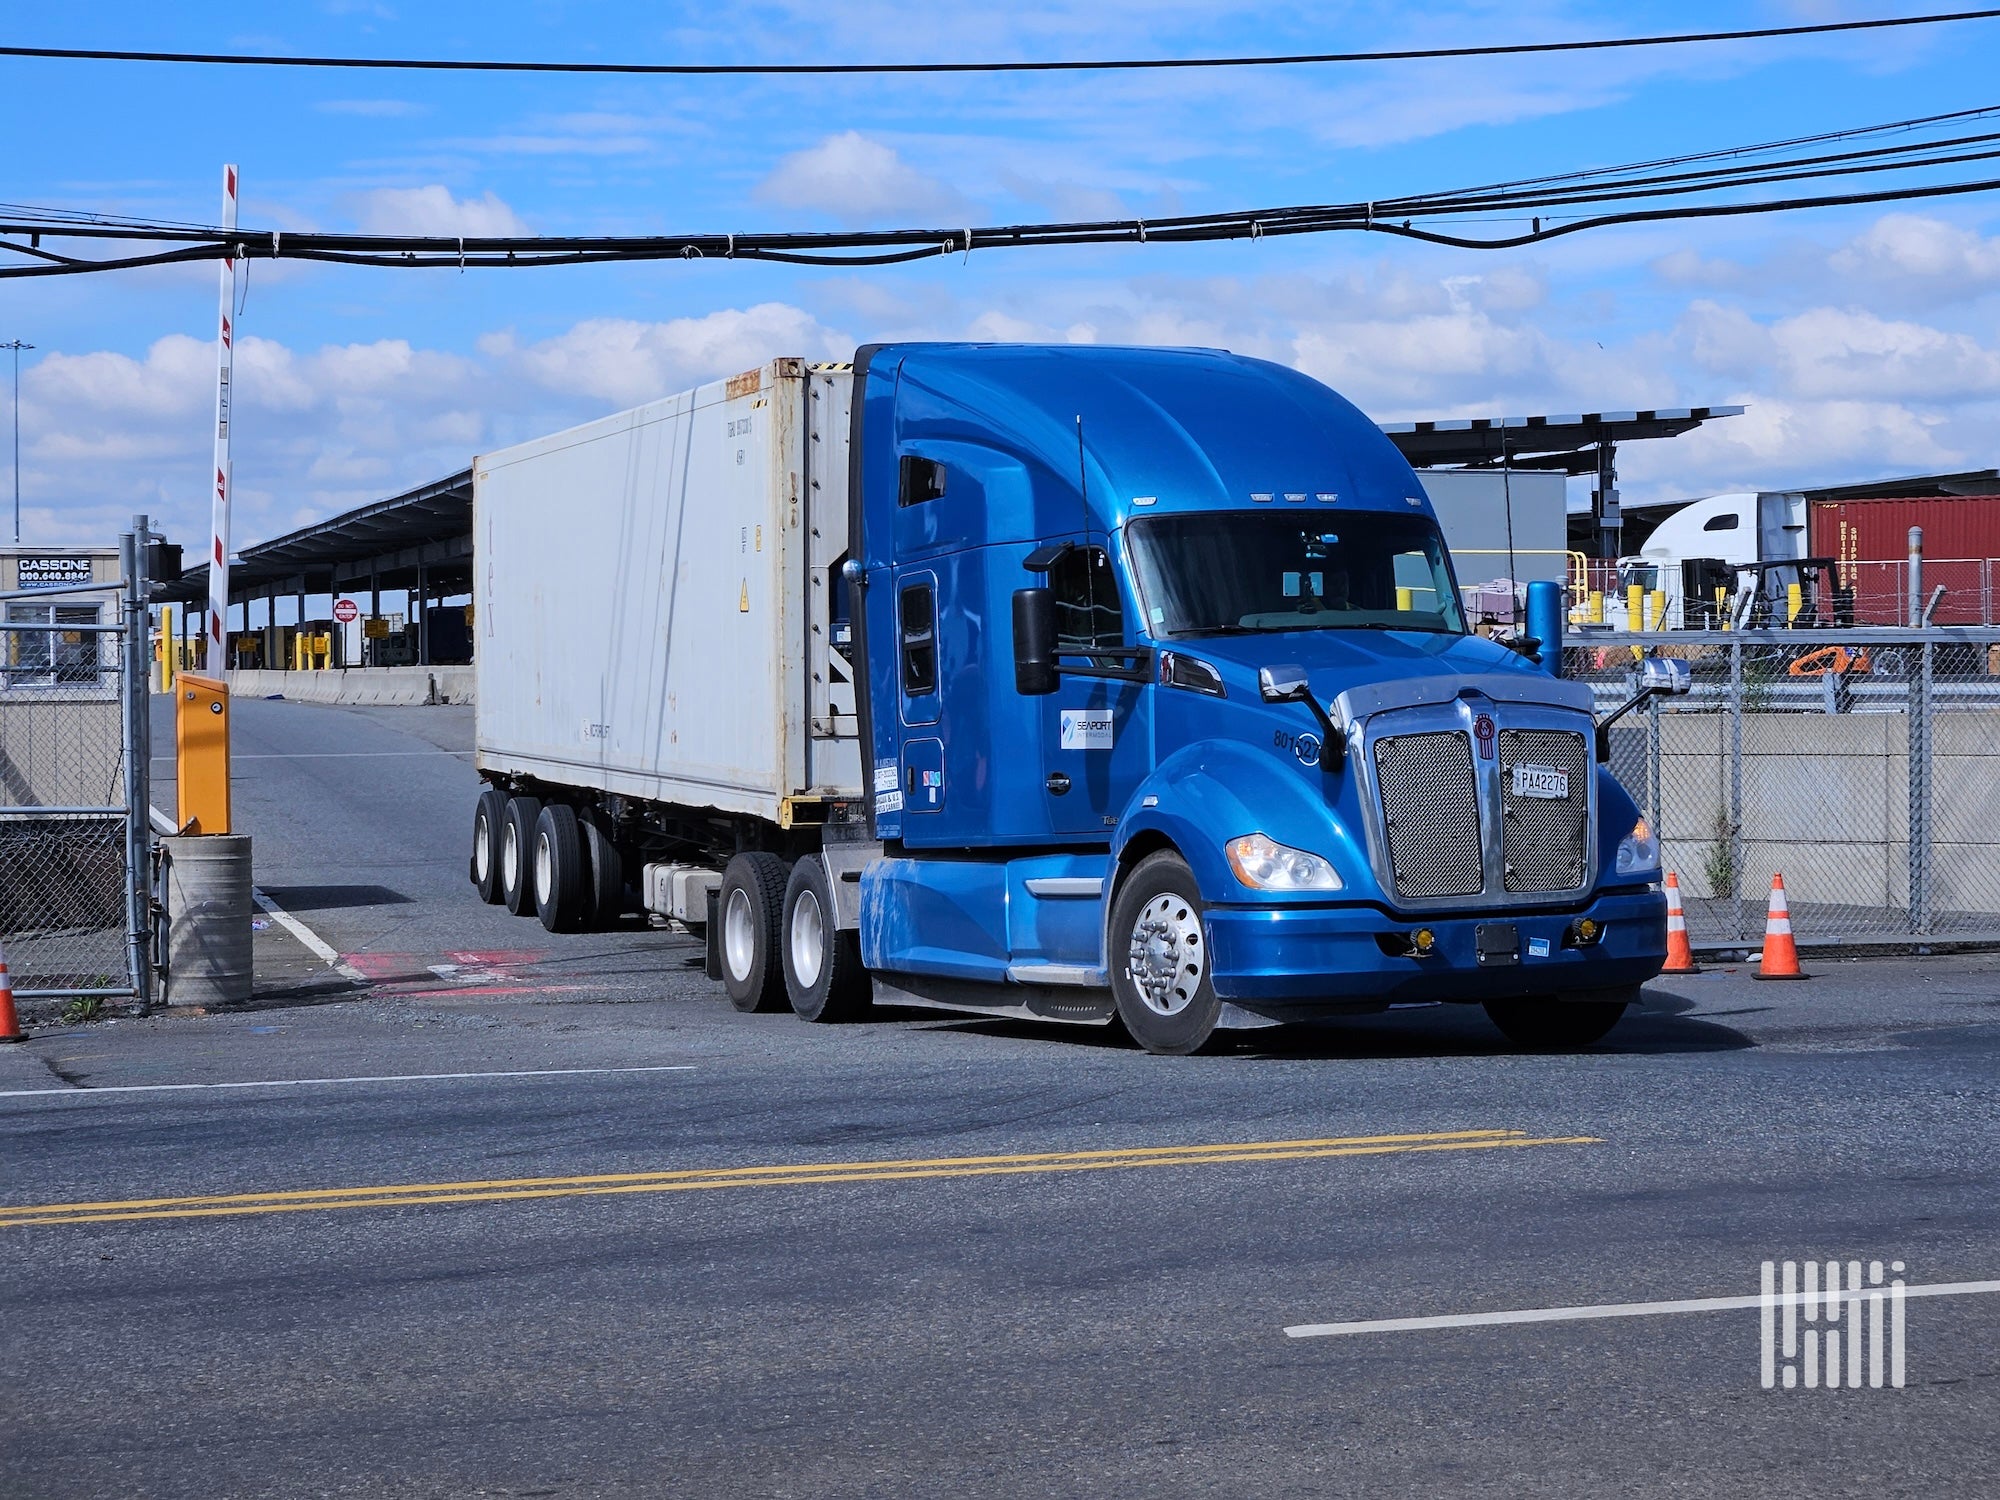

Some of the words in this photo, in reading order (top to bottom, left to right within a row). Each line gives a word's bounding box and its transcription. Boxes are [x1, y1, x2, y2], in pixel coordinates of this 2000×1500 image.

[19, 559, 90, 571] CASSONE
[1077, 721, 1112, 731] SEAPORT
[1522, 772, 1566, 791] PA42276
